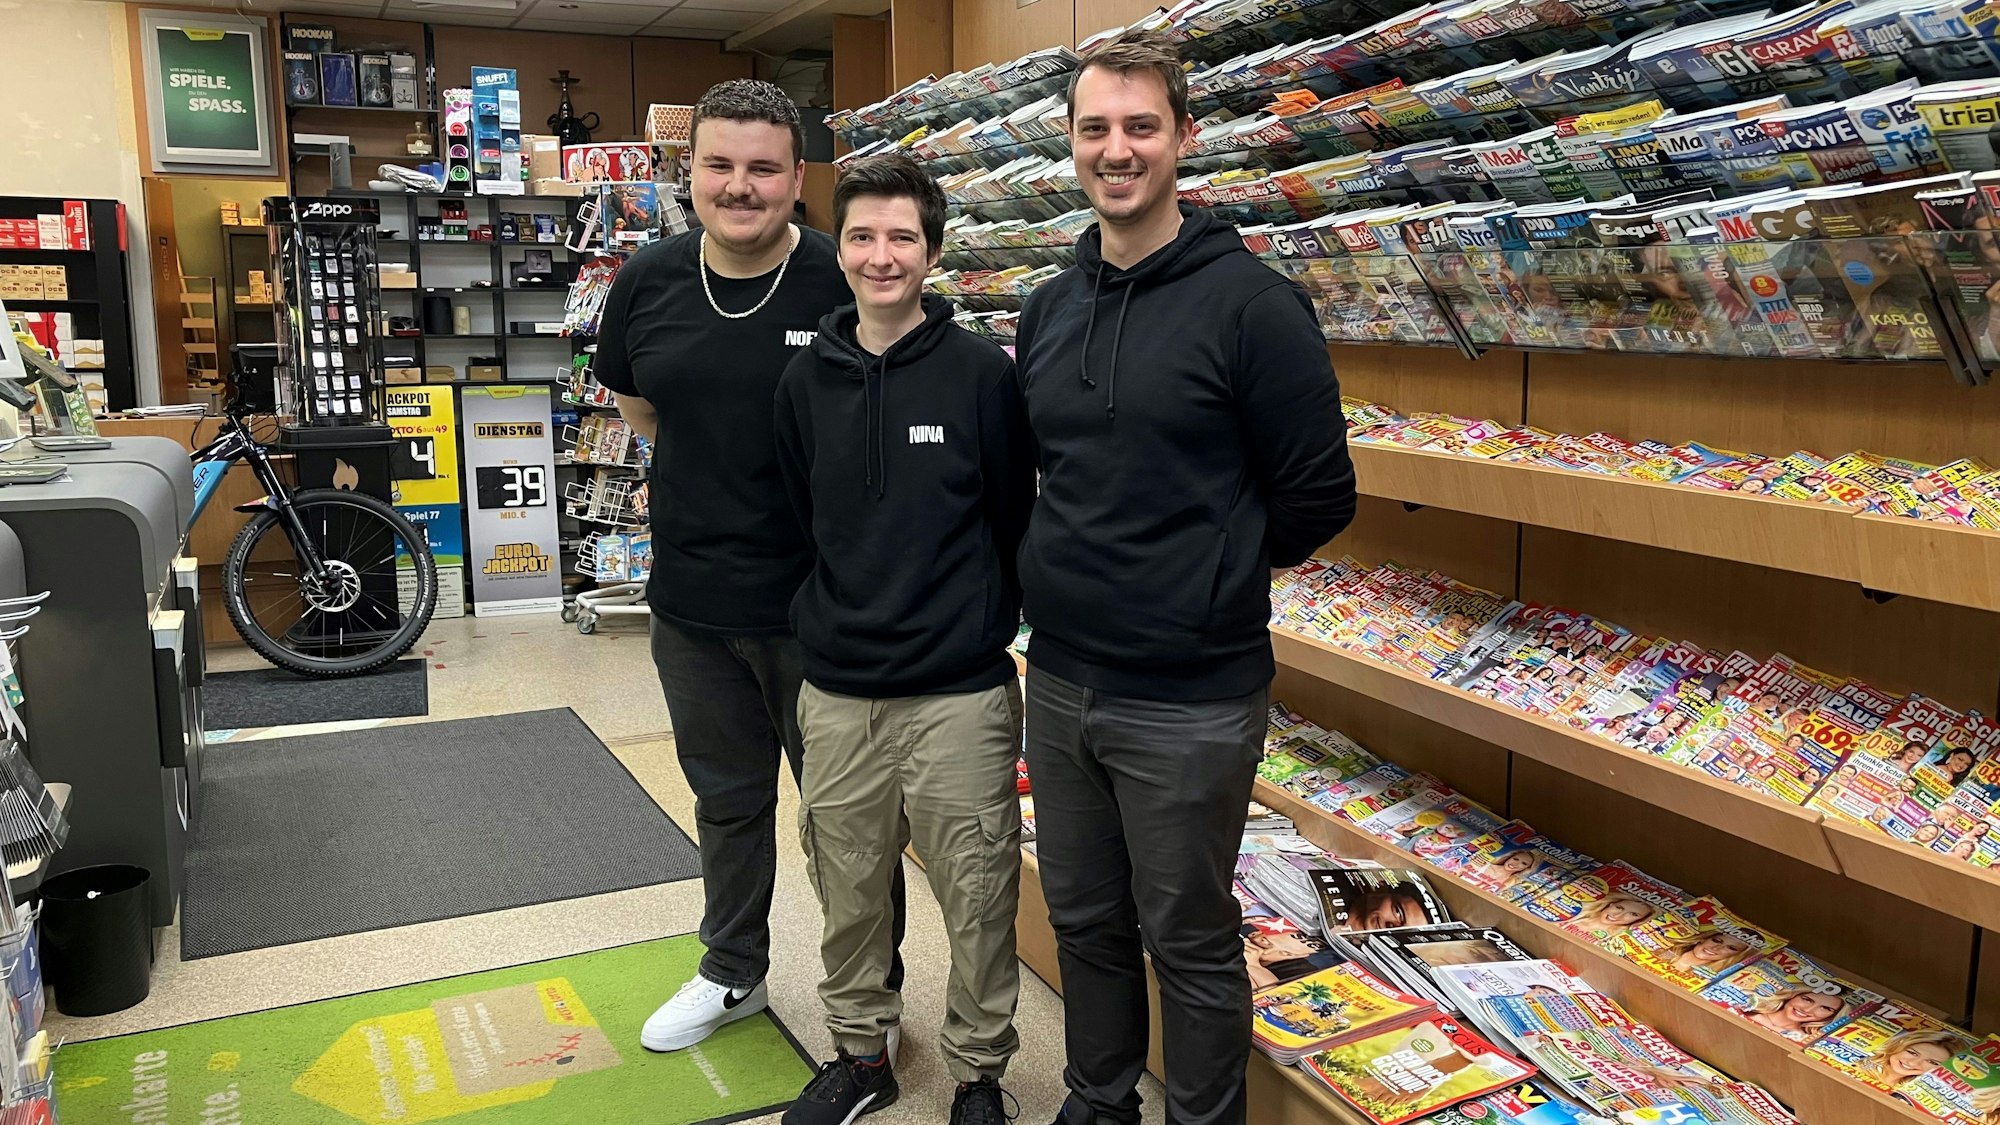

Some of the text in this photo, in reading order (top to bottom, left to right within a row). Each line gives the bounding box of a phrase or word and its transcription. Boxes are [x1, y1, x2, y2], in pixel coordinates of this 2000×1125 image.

[292, 28, 332, 39] HOOKAH
[285, 52, 312, 60] HOOKAH
[170, 74, 231, 90] SPIELE.
[476, 73, 508, 84] SNUFF!
[1555, 67, 1640, 99] Vantrip
[188, 98, 246, 113] SPASS.
[1606, 118, 1628, 126] müssen
[1629, 112, 1651, 123] reden!
[1607, 141, 1664, 158] LINUX
[1624, 154, 1660, 167] WELT
[1626, 178, 1674, 192] Linux
[302, 202, 352, 217] Zippo
[73, 207, 84, 233] Winston
[1524, 218, 1557, 232] DVD
[1534, 230, 1568, 238] SPECIAL
[1756, 277, 1768, 288] 8
[1800, 304, 1824, 314] BRAD
[1803, 312, 1824, 321] PITT
[785, 330, 818, 346] NOF
[387, 393, 430, 404] ACKPOT
[387, 407, 420, 415] SAMSTAG
[416, 425, 422, 433] 6
[436, 425, 447, 433] 49
[478, 425, 542, 436] DIENSTAG
[909, 426, 944, 444] NINA
[411, 440, 434, 475] 4
[194, 467, 209, 492] ER
[502, 467, 546, 506] 39
[404, 511, 440, 522] Spiel 77
[495, 543, 534, 559] EURO
[483, 555, 548, 574] JACKPOT
[1723, 695, 1750, 712] 100
[1840, 684, 1893, 714] neue
[1866, 734, 1900, 754] 0,99
[1852, 758, 1874, 772] ihrem
[1857, 752, 1884, 769] Dunkle
[1918, 768, 1933, 779] NUR
[1954, 798, 1969, 808] wir
[1958, 790, 1971, 800] Als
[1526, 837, 1581, 865] piccolino
[1406, 870, 1442, 925] Esqu
[1620, 881, 1676, 910] Sudoku
[1564, 924, 1600, 944] Wochen
[1620, 934, 1645, 954] Bester
[1341, 962, 1365, 978] DER
[1798, 966, 1841, 996] top
[1432, 1016, 1487, 1056] FOCUS
[1634, 1024, 1686, 1062] FUNK
[1631, 1028, 1671, 1063] UHR
[119, 1049, 168, 1125] nkarte
[1932, 1067, 1974, 1095] NEU!
[1939, 1085, 1958, 1100] 80
